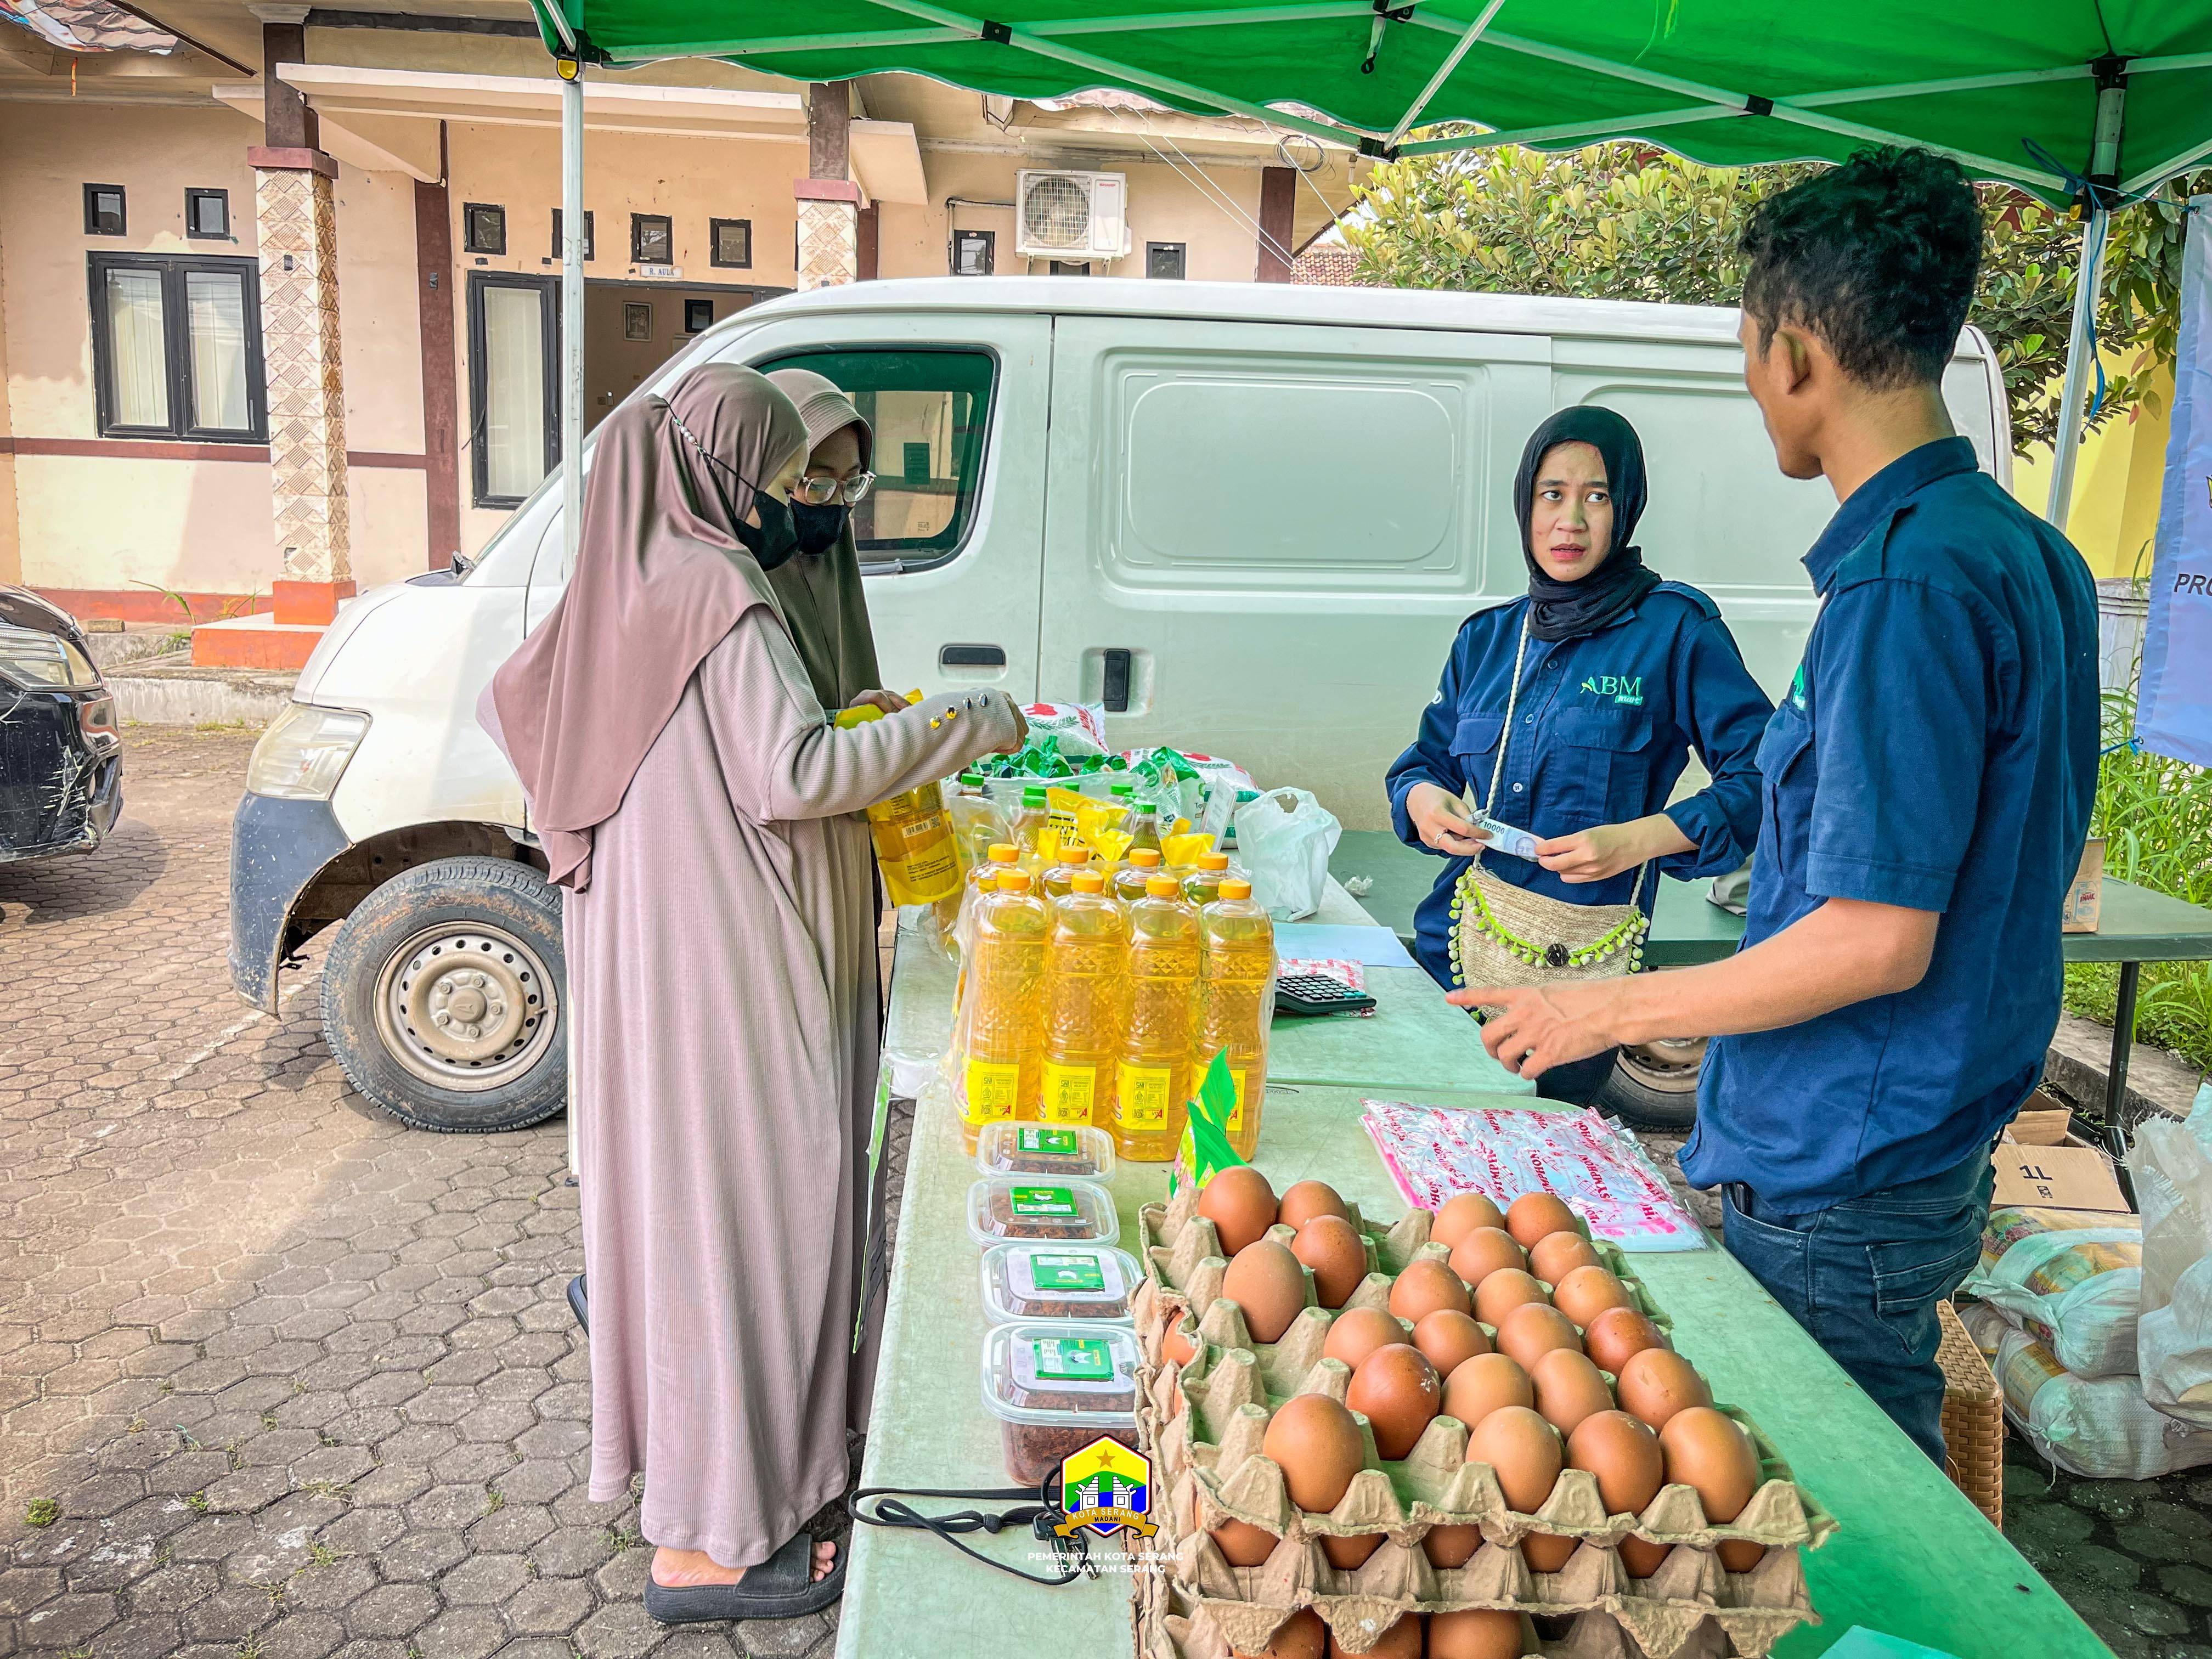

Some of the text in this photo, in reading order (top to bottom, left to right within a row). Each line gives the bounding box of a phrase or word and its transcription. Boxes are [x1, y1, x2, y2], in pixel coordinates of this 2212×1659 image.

[1580, 676, 1642, 695] ABM
[1483, 821, 1505, 834] 10000
[1578, 1154, 1613, 1201] SYMPHONI
[2019, 1165, 2053, 1181] 1L
